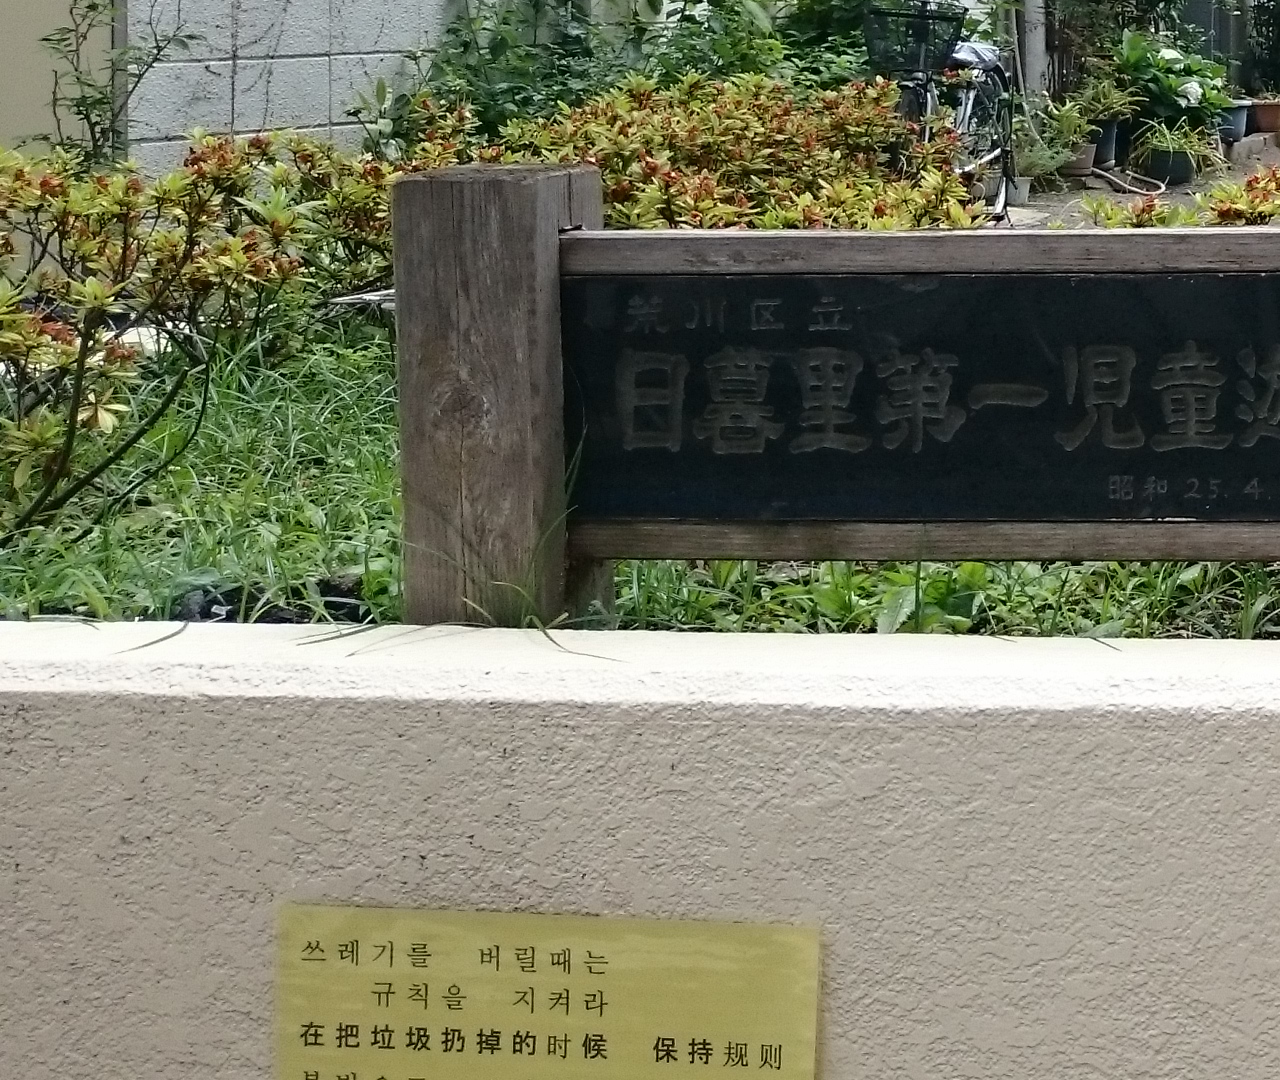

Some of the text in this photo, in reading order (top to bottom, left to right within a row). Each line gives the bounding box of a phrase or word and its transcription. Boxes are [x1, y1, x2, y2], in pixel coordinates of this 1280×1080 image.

[623, 294, 856, 333] 荒川区立
[300, 939, 610, 975] 쓰레기를 버릴때는
[371, 982, 609, 1017] 규칙을 지켜라
[299, 1021, 783, 1071] 在把垃圾扔掉的时候 保持规则
